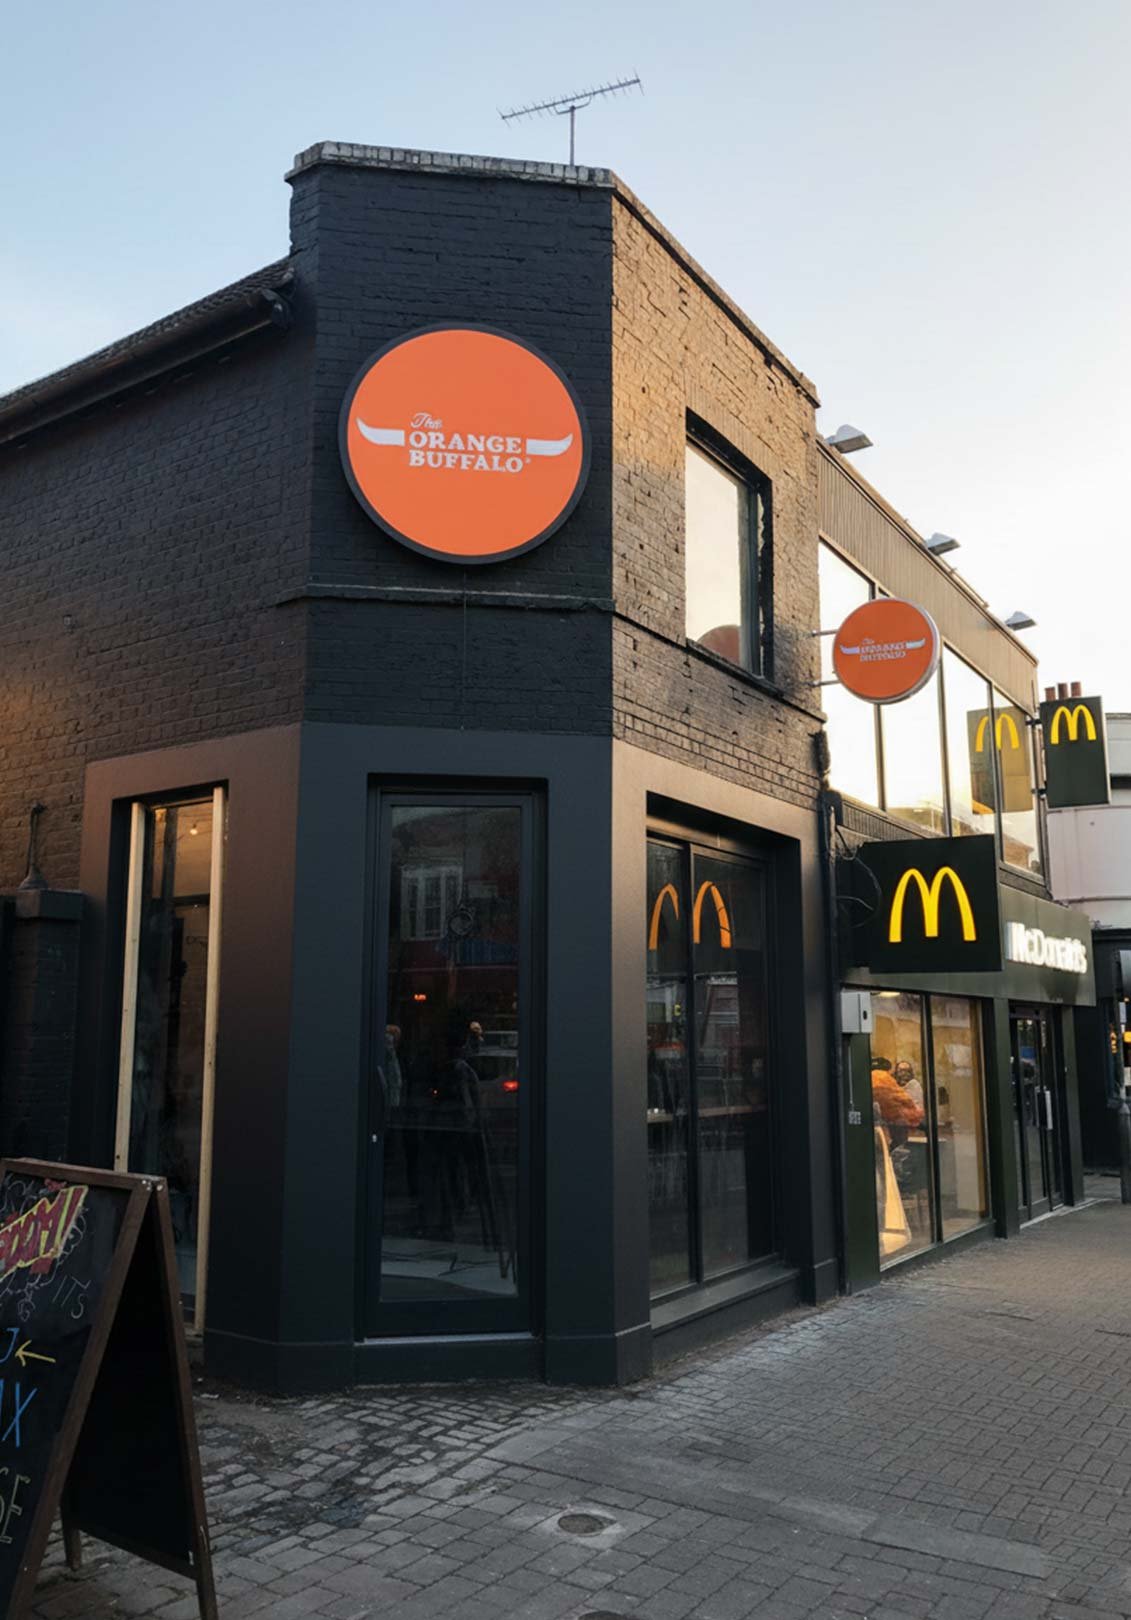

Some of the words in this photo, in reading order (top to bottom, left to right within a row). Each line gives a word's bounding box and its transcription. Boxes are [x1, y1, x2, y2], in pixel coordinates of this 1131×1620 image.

[410, 412, 442, 429] The
[409, 430, 522, 454] ORANGE
[409, 449, 524, 473] BUFFALO
